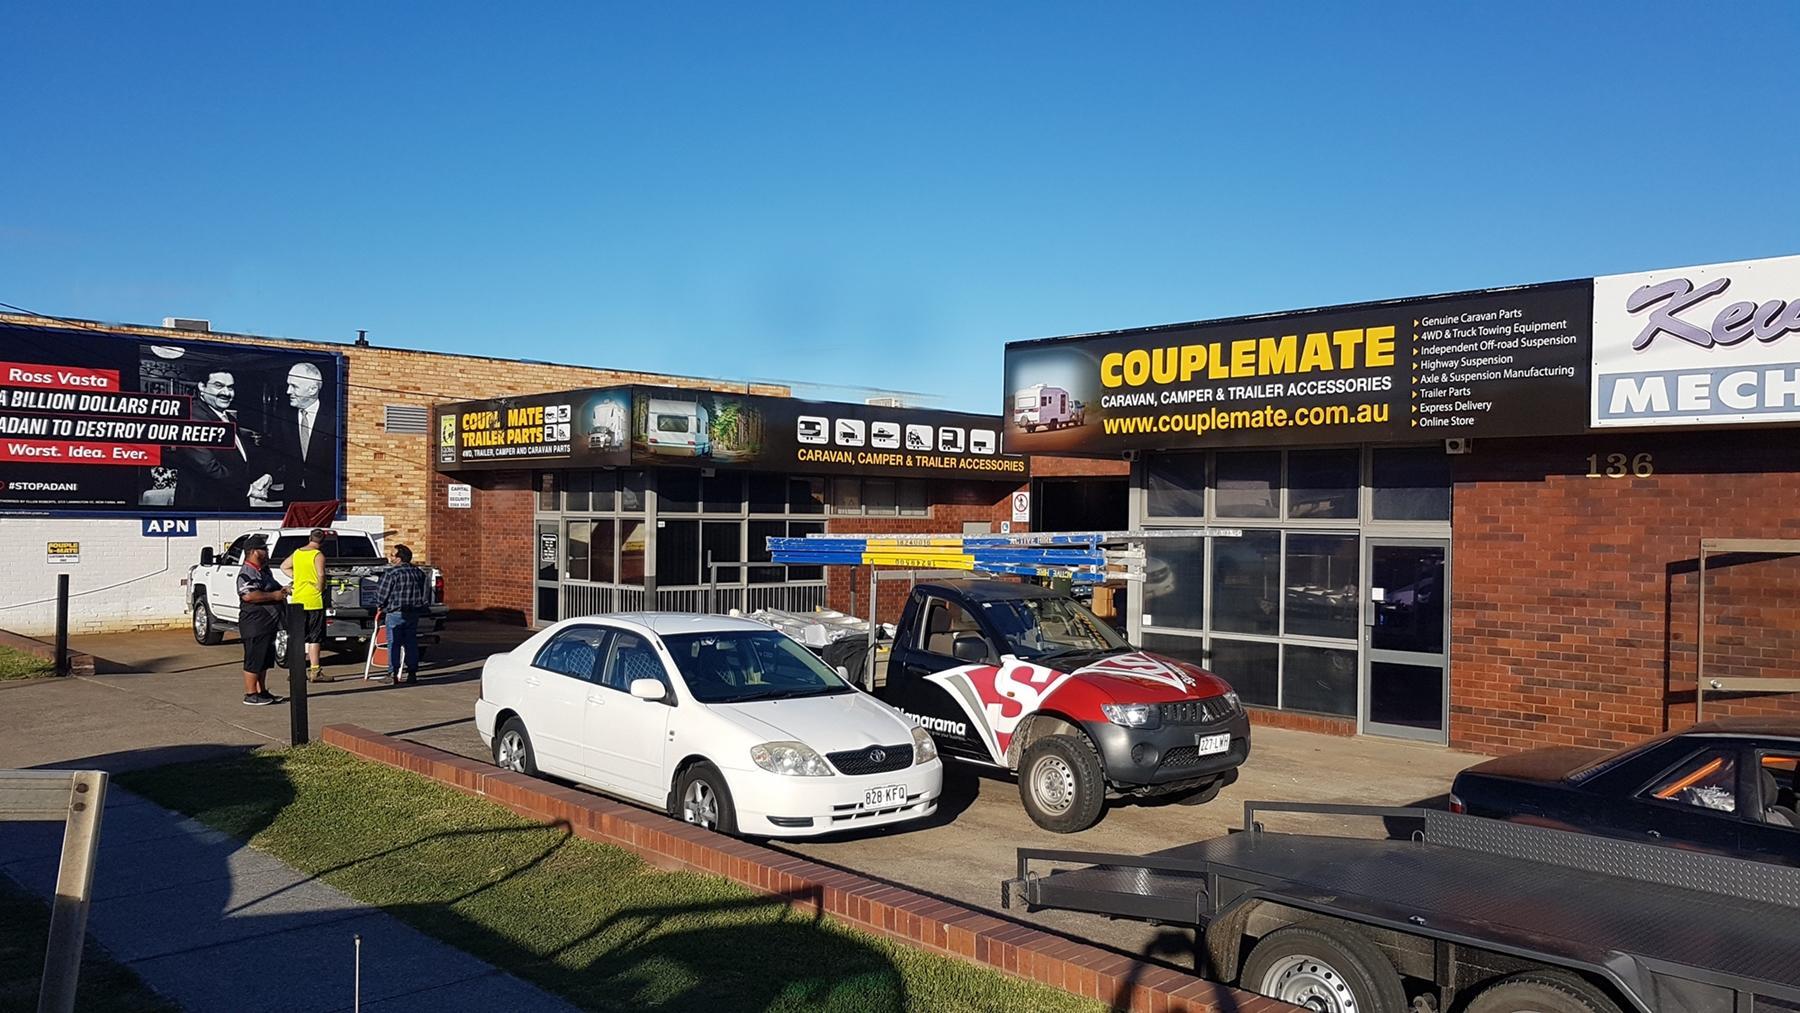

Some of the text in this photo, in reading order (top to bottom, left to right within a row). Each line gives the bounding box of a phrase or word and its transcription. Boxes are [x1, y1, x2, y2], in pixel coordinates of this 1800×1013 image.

[1422, 309, 1522, 327] Genuine Caravan Parts
[1421, 320, 1567, 341] 4WD & Truck Towing Equipment
[1421, 334, 1576, 356] Independent Off-road Suspension
[1101, 326, 1395, 388] COUPLEMATE
[1420, 354, 1513, 371] Highway Suspension
[9, 368, 108, 387] Ross Vasta
[1420, 366, 1574, 384] Axle & Suspension Manufacturing
[1101, 376, 1392, 408] CARAVAN, CAMPER & TRAILER ACCESSORIES
[1420, 386, 1471, 398] Trailer Parts
[11, 390, 76, 410] BILLION
[79, 394, 148, 414] DOLLARS
[150, 400, 180, 416] FOR
[1420, 400, 1492, 414] Express Delivery
[508, 406, 544, 427] MATE
[1103, 403, 1389, 436] www.couplemate.com.au
[1420, 416, 1474, 428] Online Store
[0, 416, 226, 442] ADANI TO DESTROY OUR REEF?
[462, 427, 543, 447] TRAILER PARTS
[8, 443, 148, 460] Worst. Idea. Ever.
[496, 448, 516, 456] CAMPER
[516, 447, 528, 455] AND
[528, 446, 552, 454] CARAVAN
[554, 444, 570, 452] PARTS
[798, 449, 1024, 472] CARAVAN, CAMPER & TRAILER ACCESSORIES
[1586, 454, 1654, 478] 136
[8, 482, 77, 491] #STOPADANI
[148, 520, 189, 532] APN
